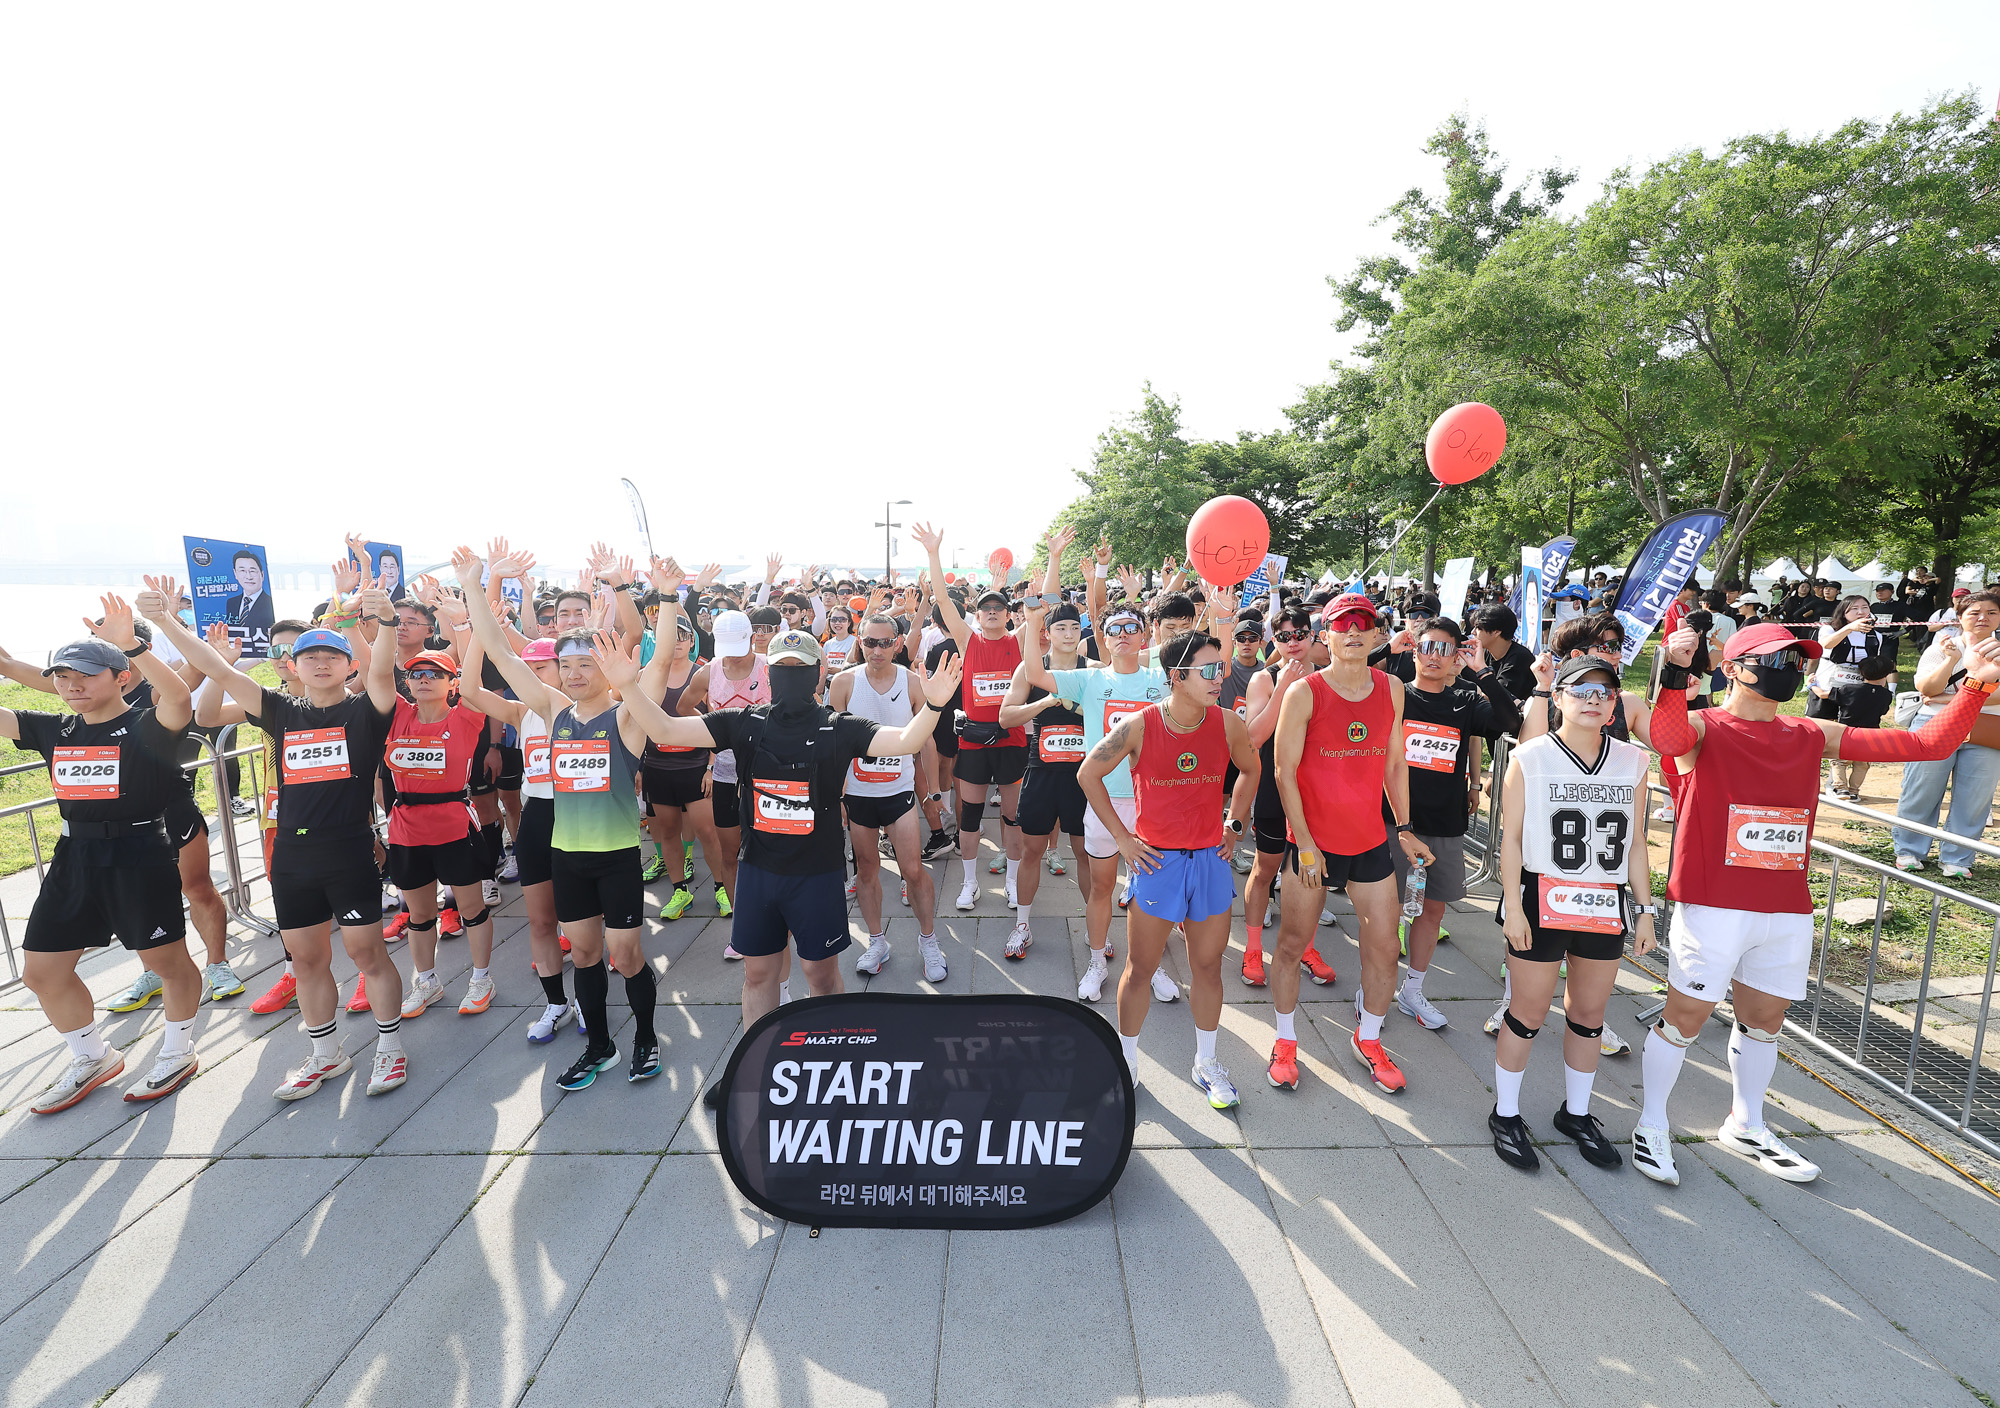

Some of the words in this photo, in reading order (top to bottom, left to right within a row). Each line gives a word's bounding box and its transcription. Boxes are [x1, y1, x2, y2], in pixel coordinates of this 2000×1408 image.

[1193, 533, 1259, 576] 40분
[1641, 527, 1706, 621] 정근식
[196, 586, 209, 598] 더
[989, 682, 1011, 691] 1592
[1058, 738, 1084, 746] 1893
[1411, 738, 1421, 747] M
[1423, 738, 1458, 753] 2457
[287, 752, 297, 761] M
[301, 744, 342, 760] 2551
[407, 752, 444, 762] 3802
[534, 754, 544, 762] W
[1319, 746, 1370, 760] Kwanghwamun
[58, 768, 67, 776] M
[70, 765, 116, 776] 2026
[559, 760, 567, 769] M
[569, 758, 607, 769] 2489
[577, 780, 593, 788] C-57
[1150, 776, 1200, 788] Kwanghwamun
[1201, 774, 1222, 784] Pacing
[1549, 783, 1635, 804] LEGEND
[762, 800, 771, 809] M
[1550, 807, 1630, 875] 83
[1746, 829, 1760, 840] M
[1763, 828, 1804, 843] 2461
[1554, 893, 1568, 903] W
[1572, 892, 1617, 908] 4356
[780, 1032, 846, 1046] SMART
[847, 1035, 878, 1045] CHIP
[769, 1061, 924, 1106] START
[768, 1119, 964, 1166] WAITING
[976, 1120, 1086, 1166] LINE
[820, 1183, 855, 1206] 라인
[860, 1184, 914, 1207] 뒤에서
[919, 1184, 1028, 1207] 대기해주세요
